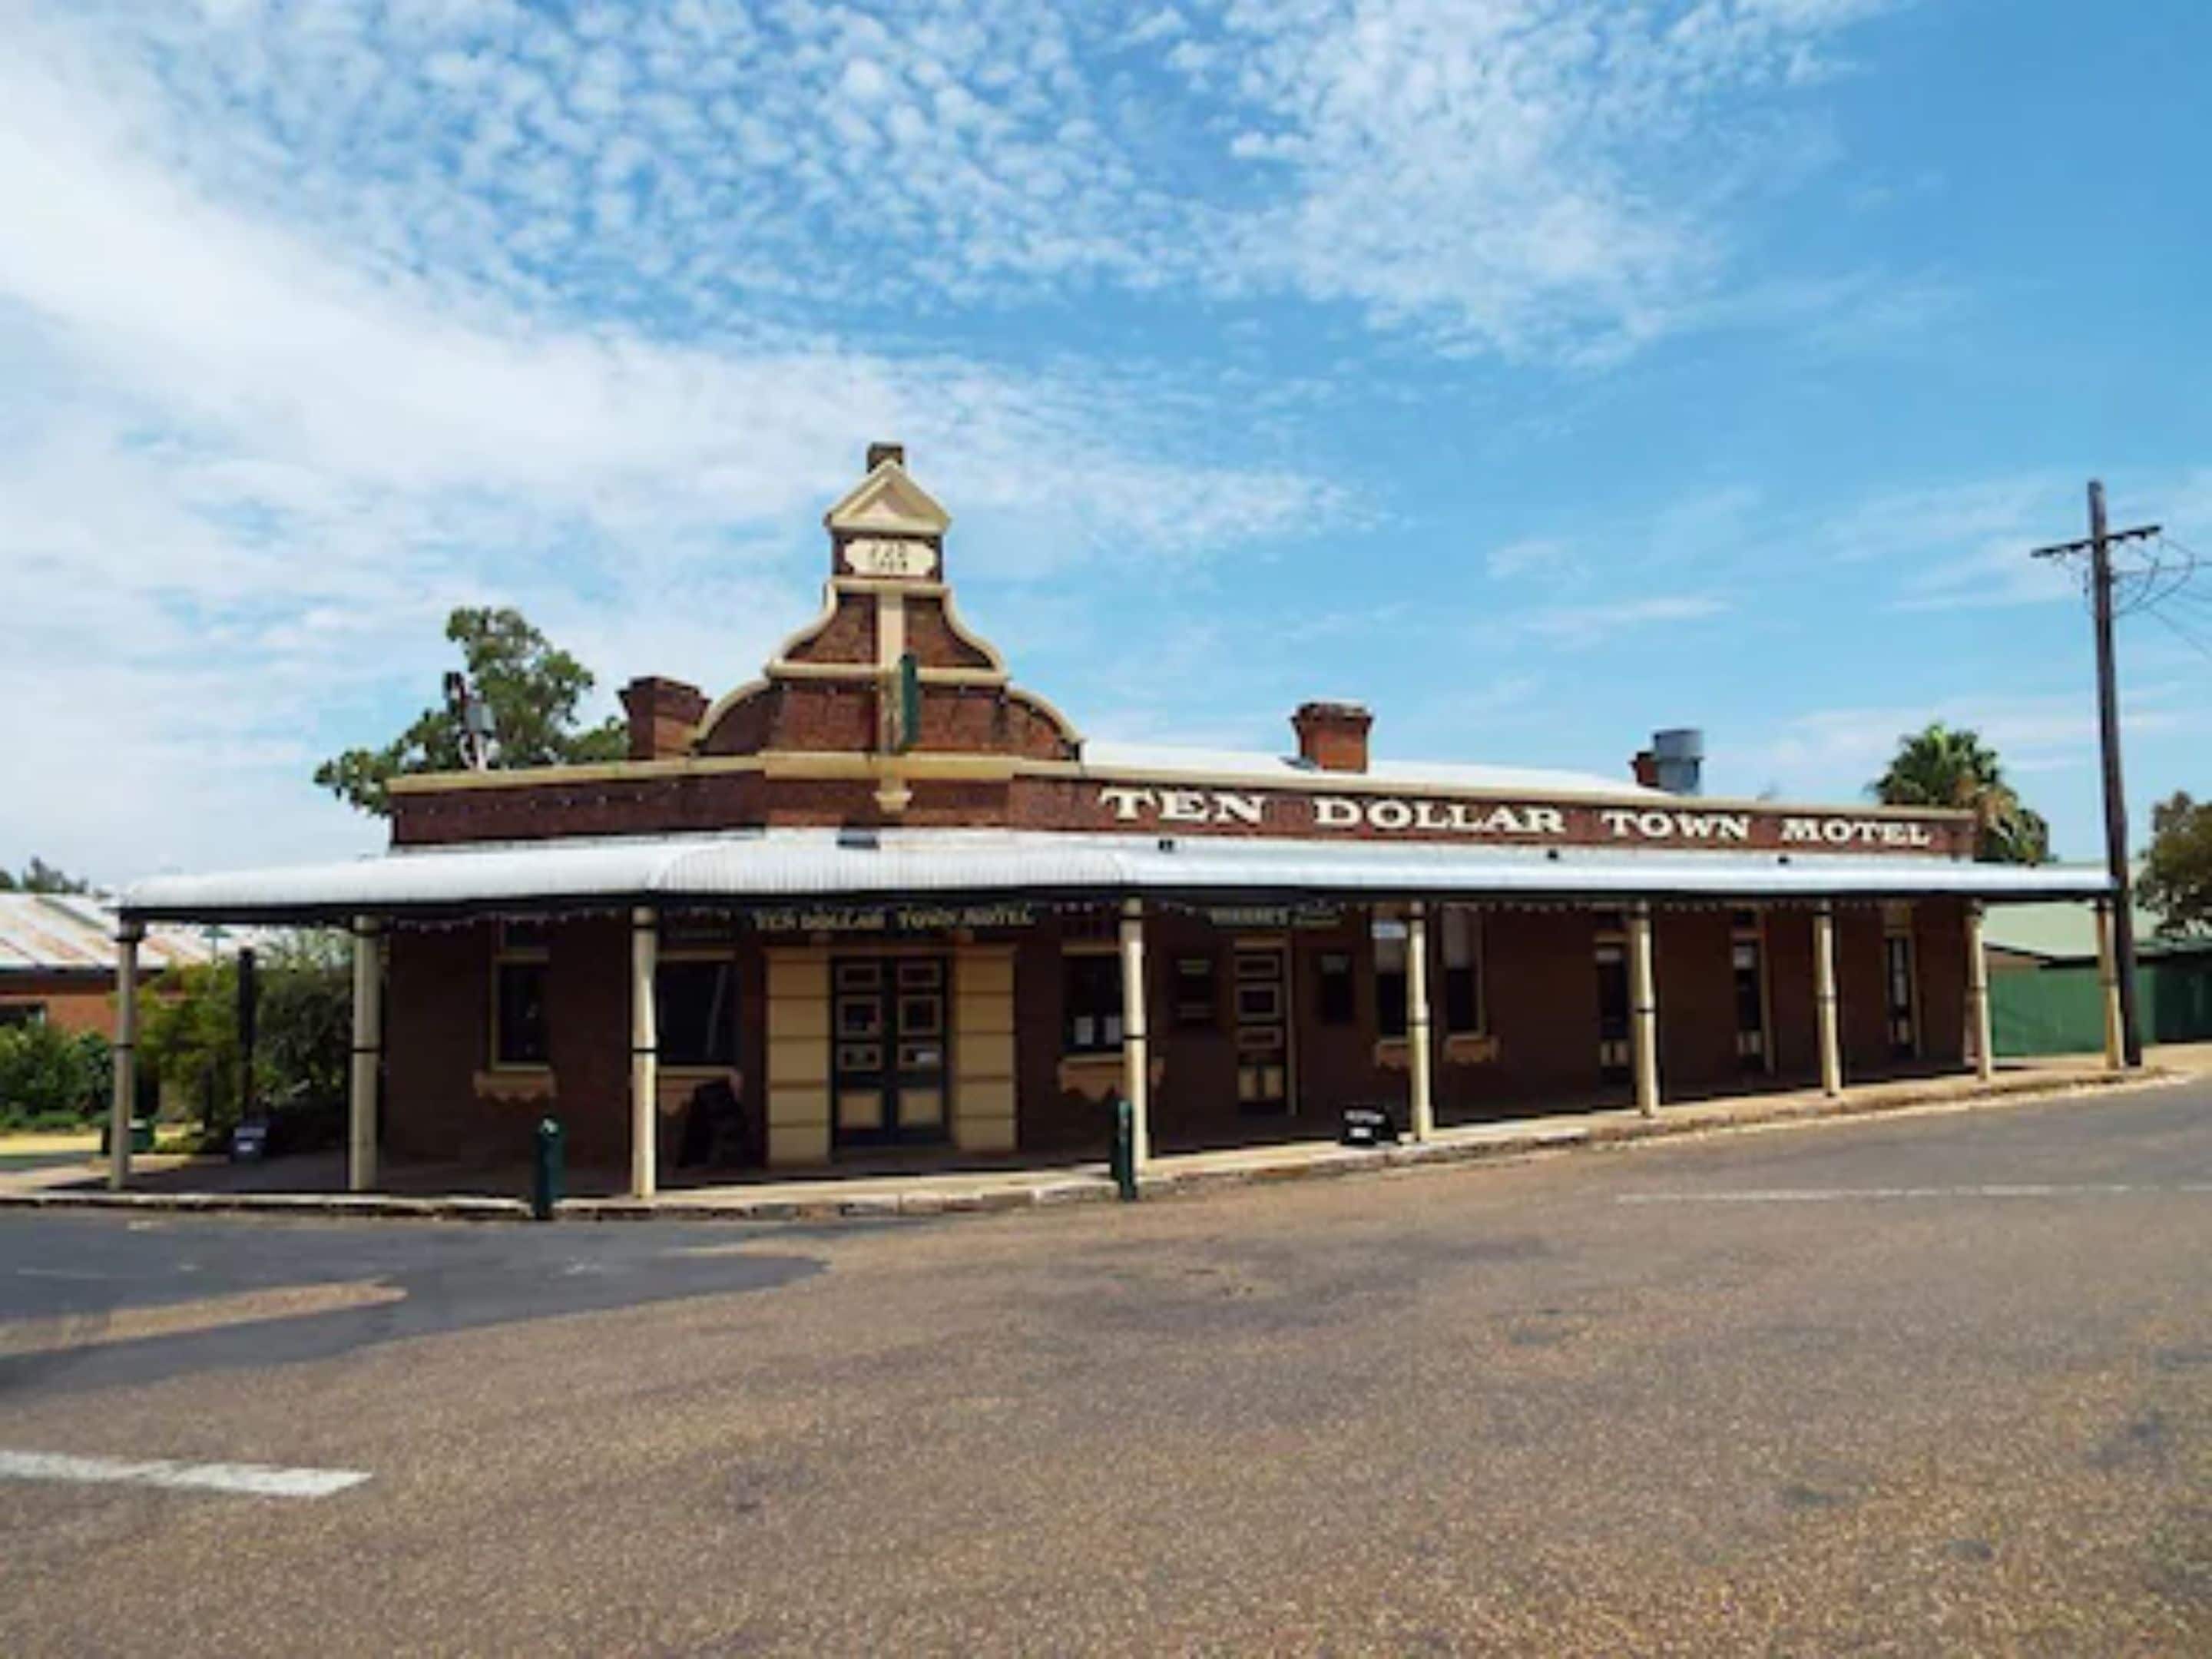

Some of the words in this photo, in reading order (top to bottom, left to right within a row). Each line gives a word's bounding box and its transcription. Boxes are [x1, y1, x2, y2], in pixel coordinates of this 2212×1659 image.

[1098, 786, 1266, 823] TEN
[1313, 796, 1566, 833] DOLLAR
[1601, 810, 1750, 839] TOWN
[1780, 817, 1930, 846] MOTEL
